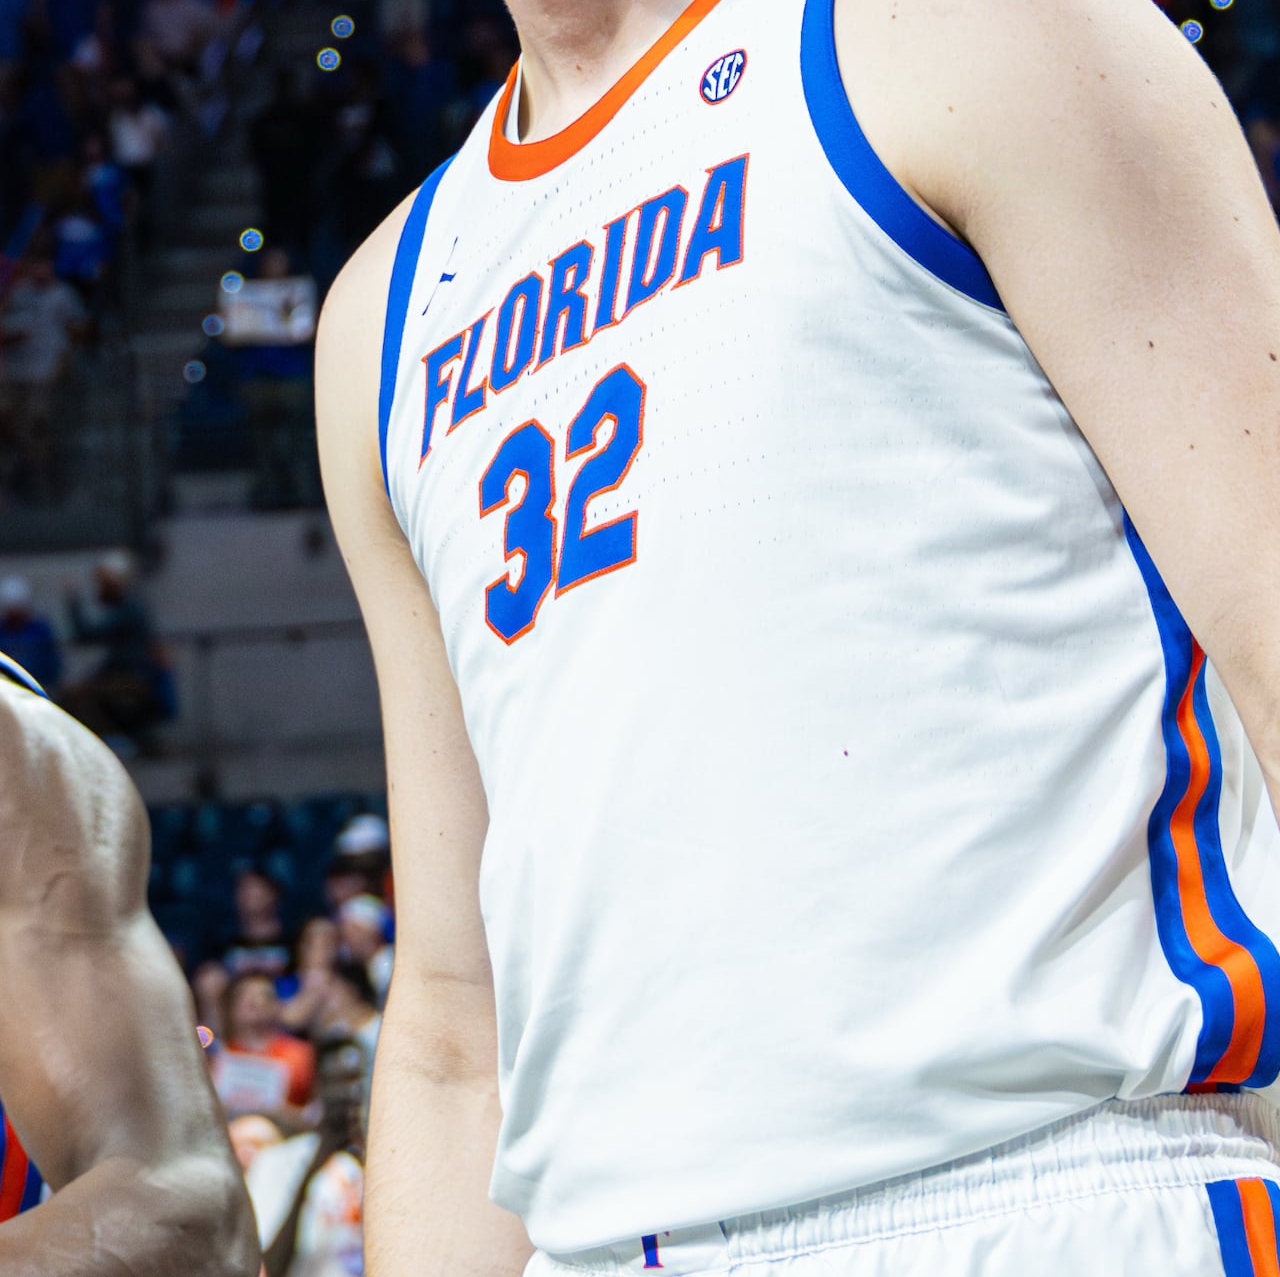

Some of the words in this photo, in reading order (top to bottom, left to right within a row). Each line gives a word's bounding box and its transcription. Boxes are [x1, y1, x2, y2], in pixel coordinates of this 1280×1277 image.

[702, 52, 744, 101] SEC
[419, 153, 750, 473] FLORIDA
[478, 361, 647, 646] 32
